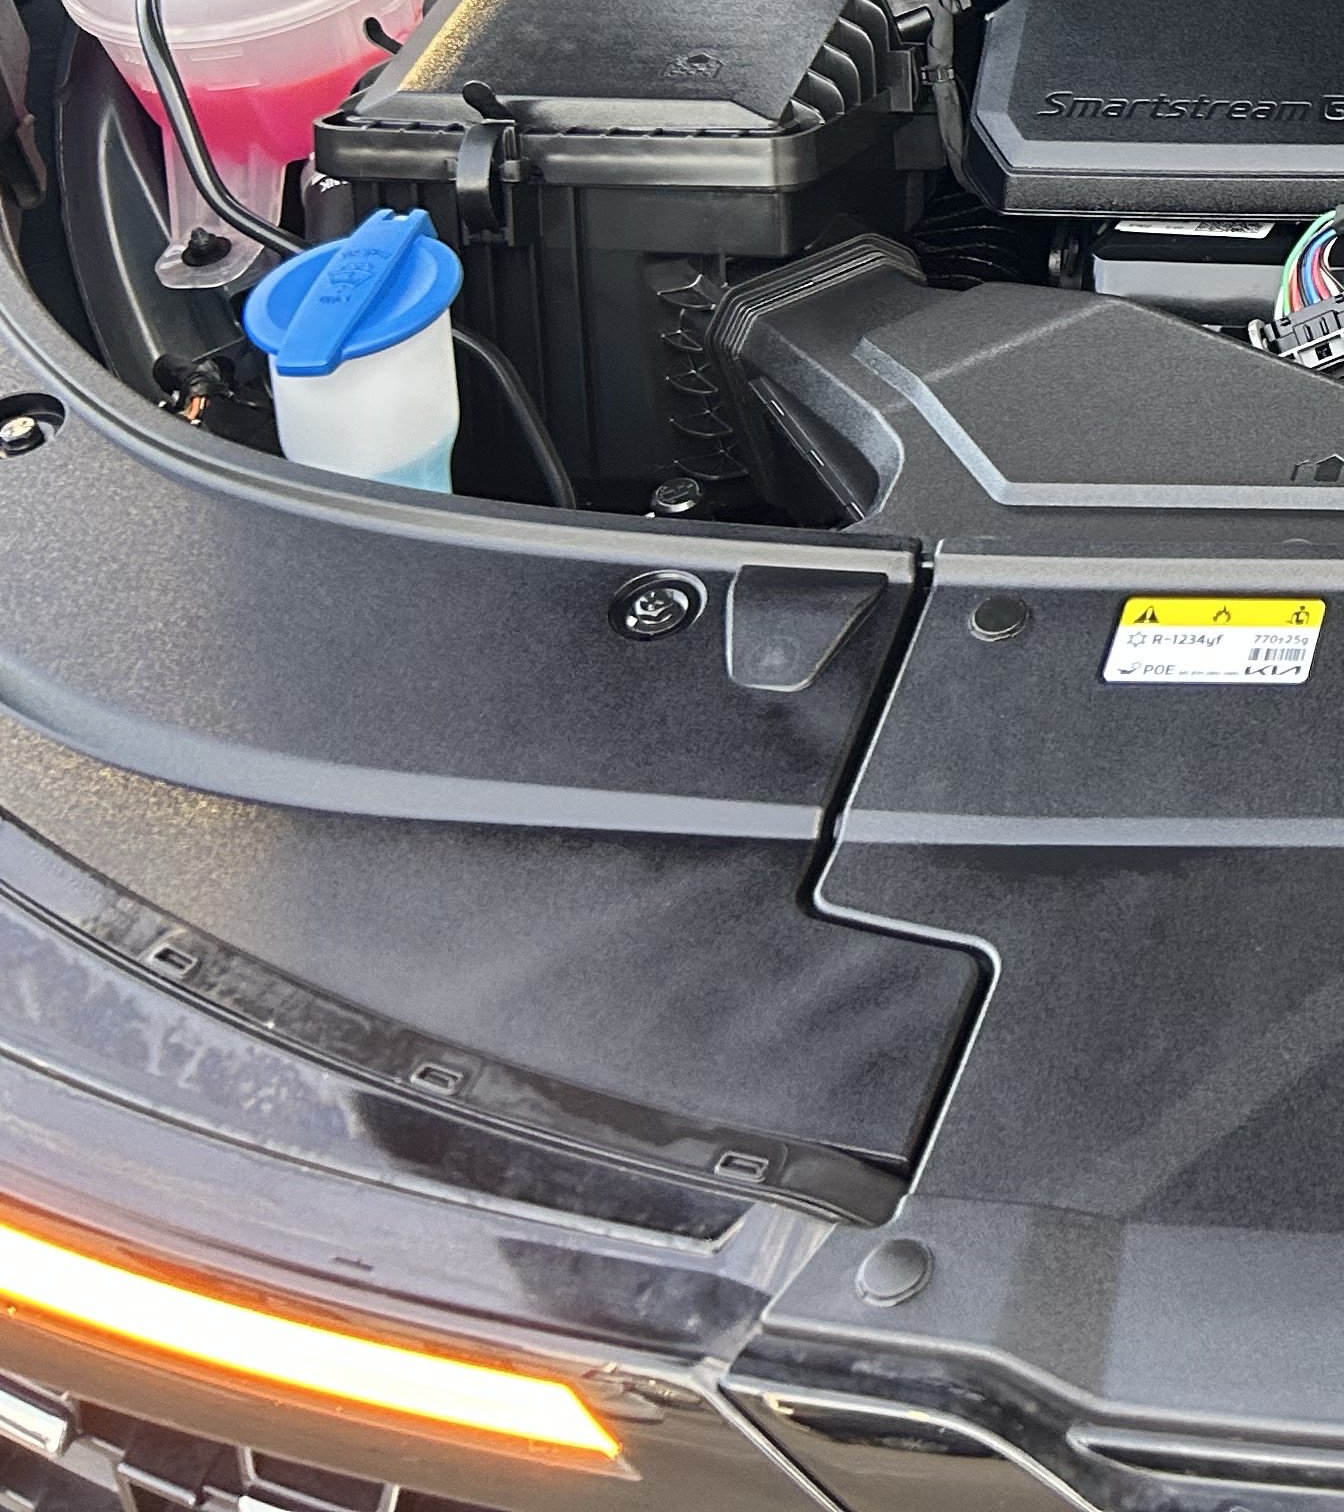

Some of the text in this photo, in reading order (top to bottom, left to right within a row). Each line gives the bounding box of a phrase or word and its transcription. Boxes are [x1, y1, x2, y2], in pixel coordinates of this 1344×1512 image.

[1037, 90, 1312, 121] Smartstream
[1152, 633, 1224, 647] R-1234yf
[1143, 664, 1176, 675] POE
[1244, 665, 1302, 676] KIA
